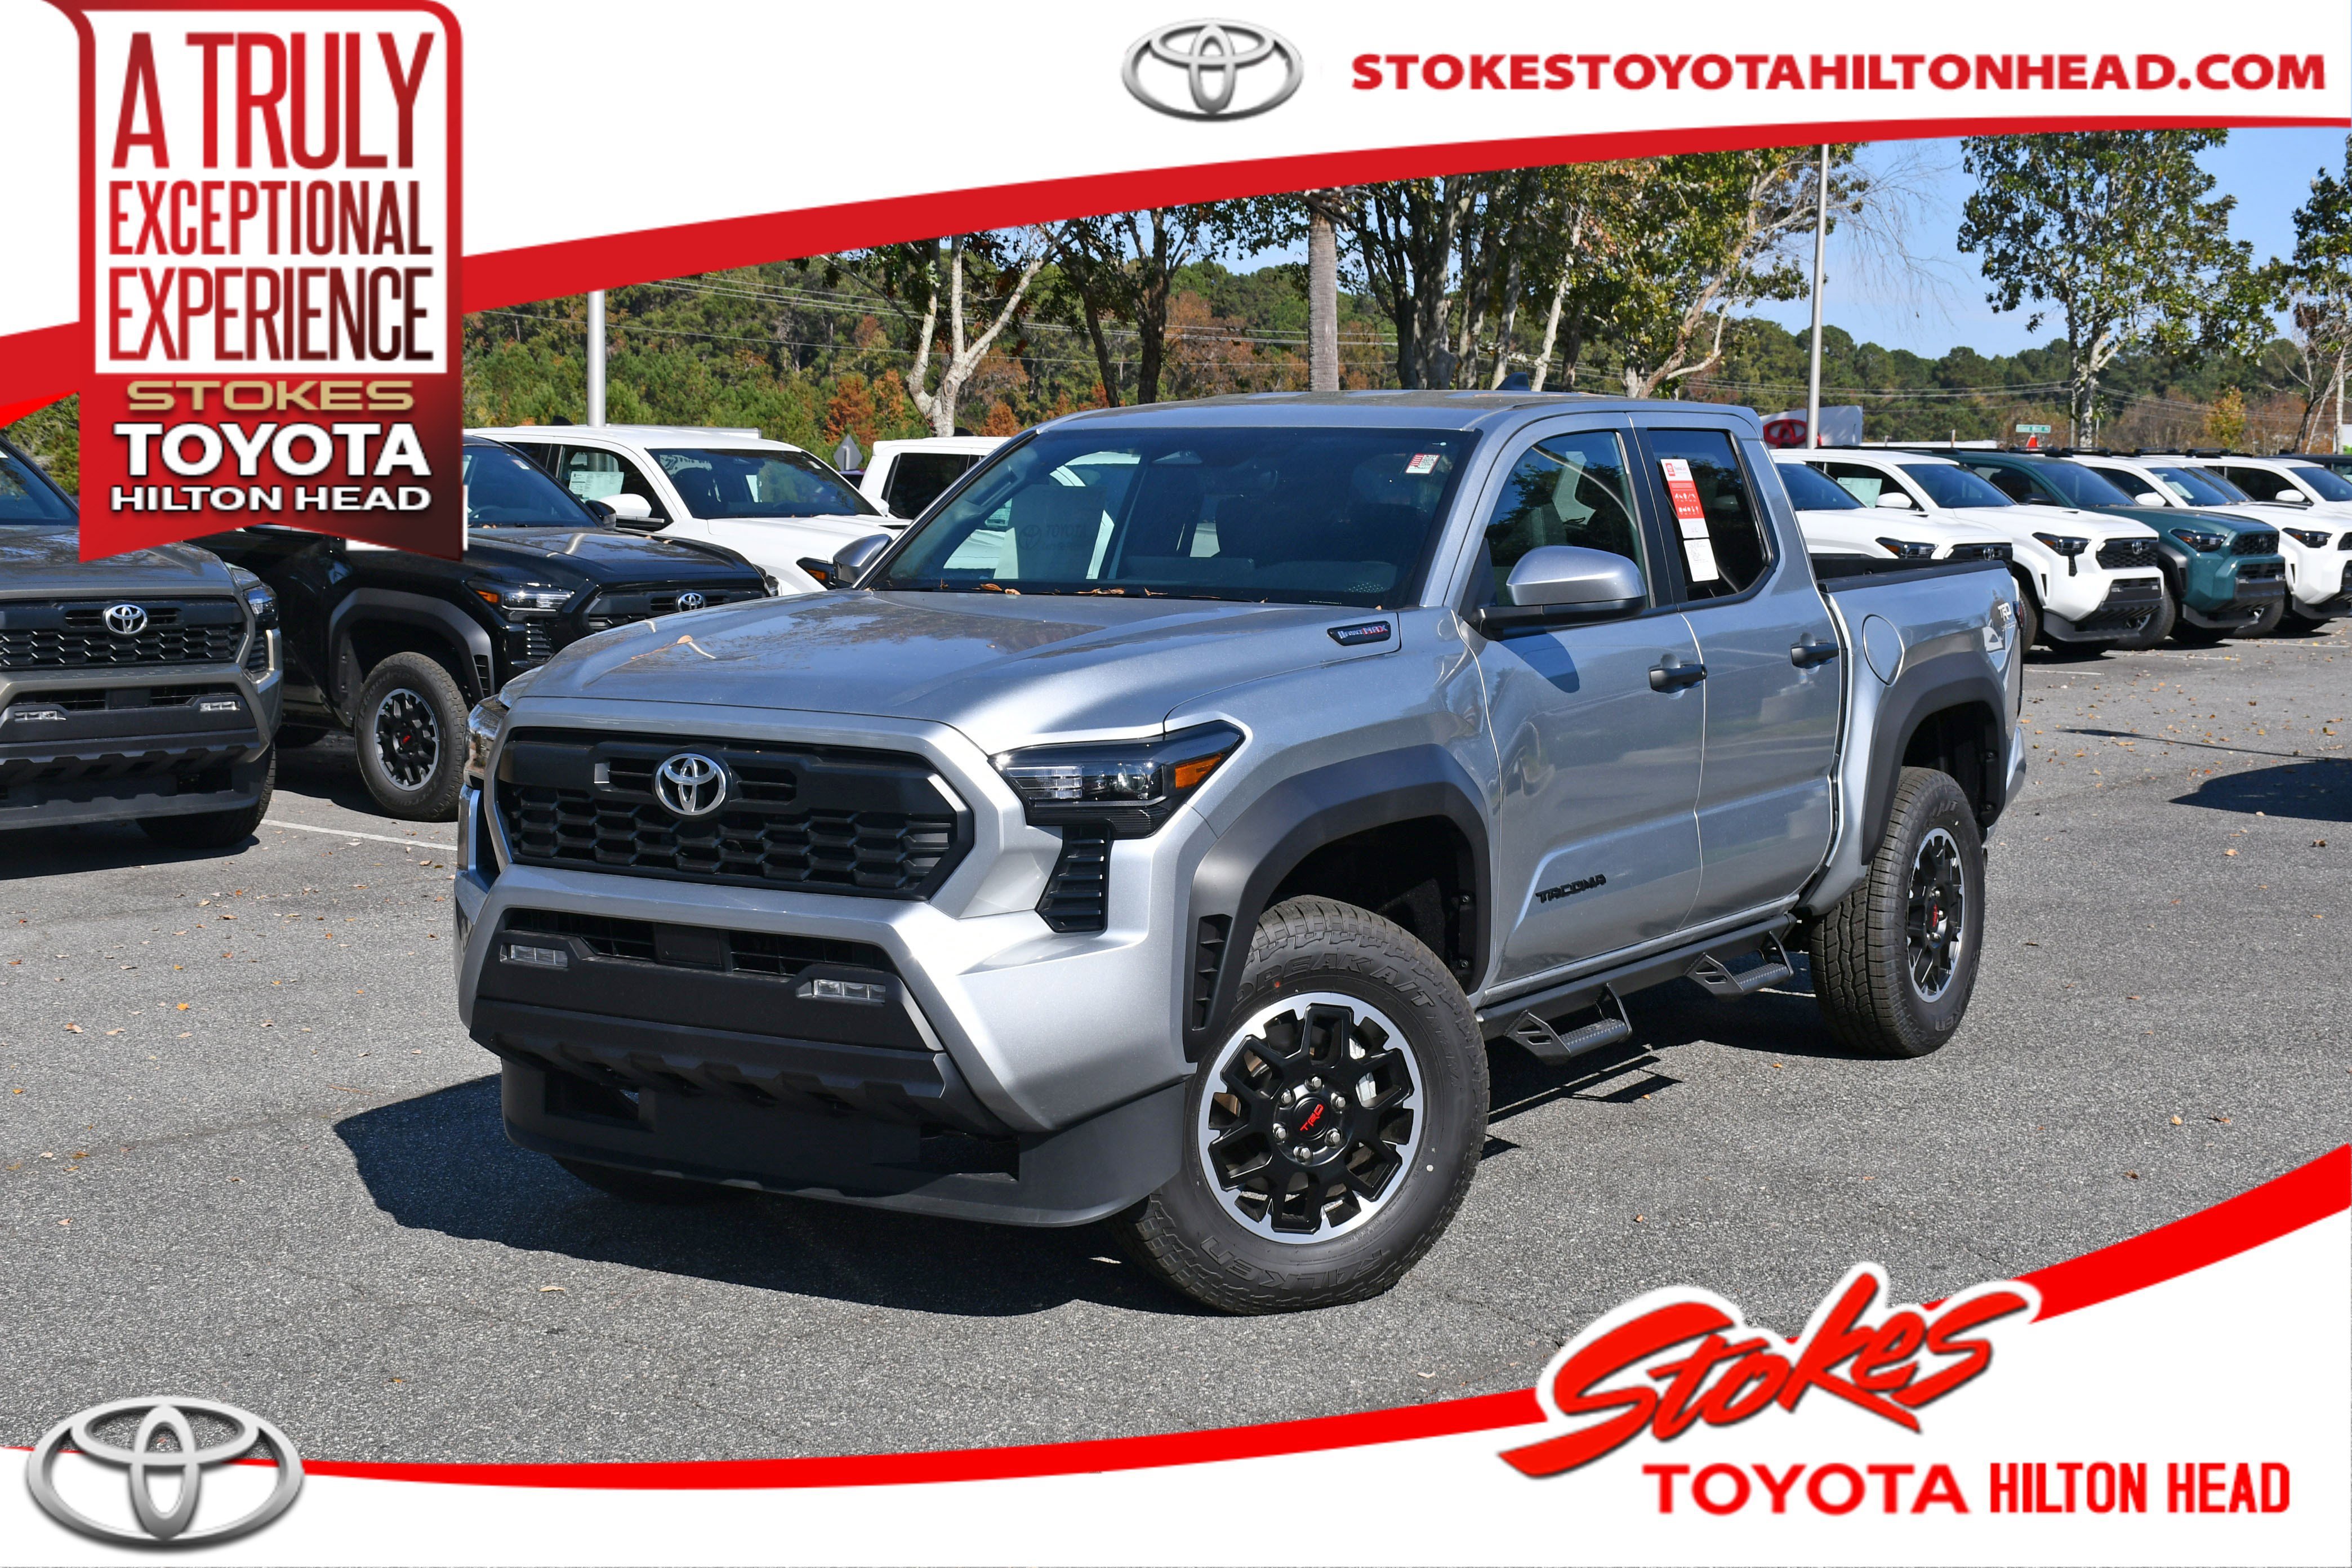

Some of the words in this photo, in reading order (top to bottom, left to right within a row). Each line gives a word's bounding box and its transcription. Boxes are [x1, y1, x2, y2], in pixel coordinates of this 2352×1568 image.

[1997, 602, 2012, 622] TRD
[1535, 874, 1607, 903] TACOMA
[1300, 1103, 1325, 1132] TRD
